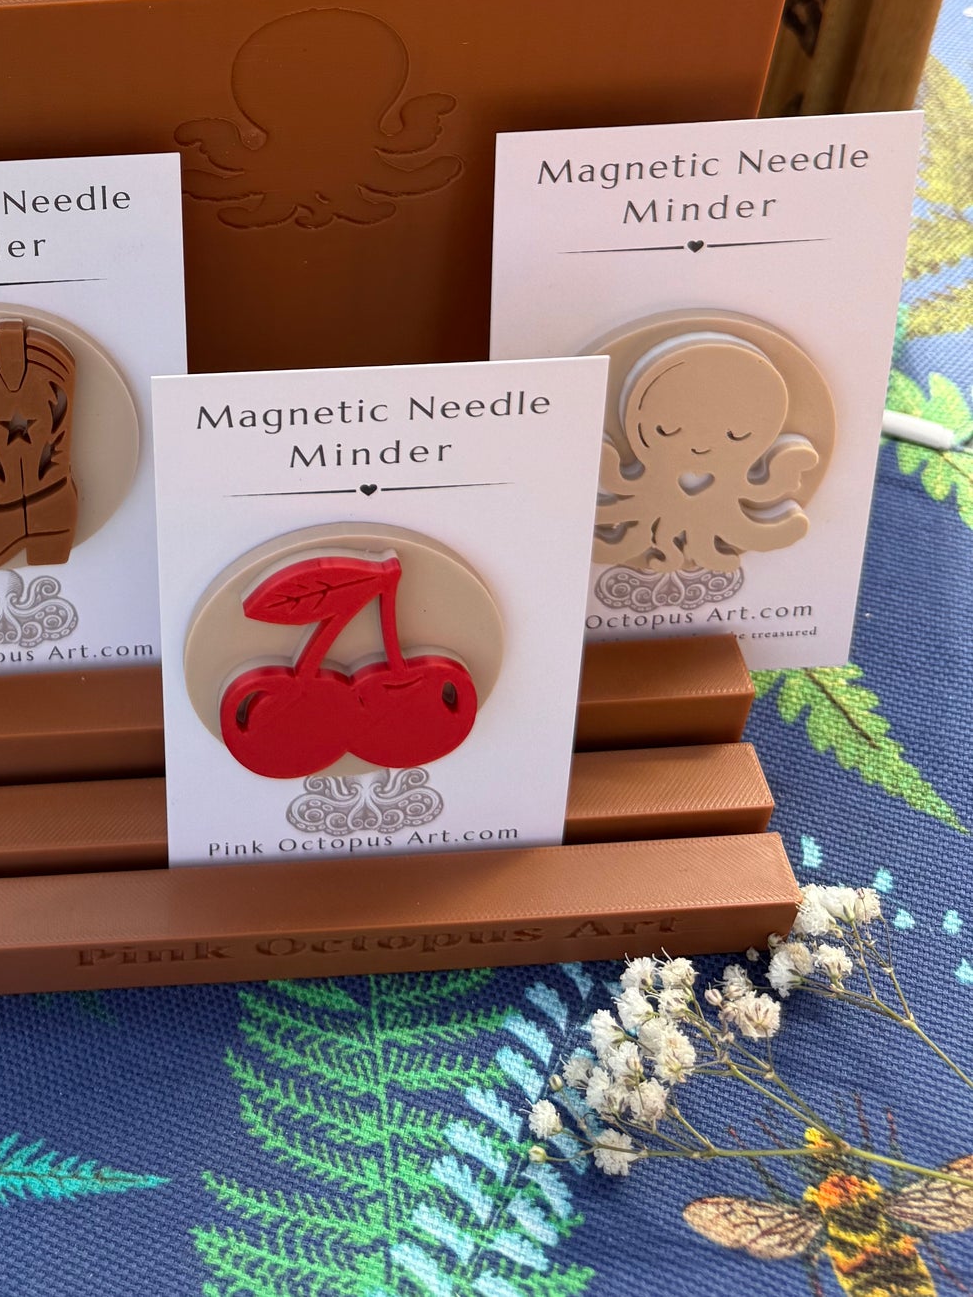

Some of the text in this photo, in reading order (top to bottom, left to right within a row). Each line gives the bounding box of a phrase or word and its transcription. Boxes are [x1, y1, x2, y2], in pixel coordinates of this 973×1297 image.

[537, 143, 871, 190] Magnetic Needle
[3, 185, 131, 216] Needle
[622, 194, 778, 225] Minder
[196, 390, 552, 435] Magnetic Needle
[290, 440, 453, 469] Minder
[585, 604, 813, 630] Octopus Art.com
[752, 626, 817, 640] treasured
[48, 642, 154, 660] Art.com
[209, 826, 519, 856] Pink Octopus Art.com
[77, 916, 683, 966] Pink Octopus Art
